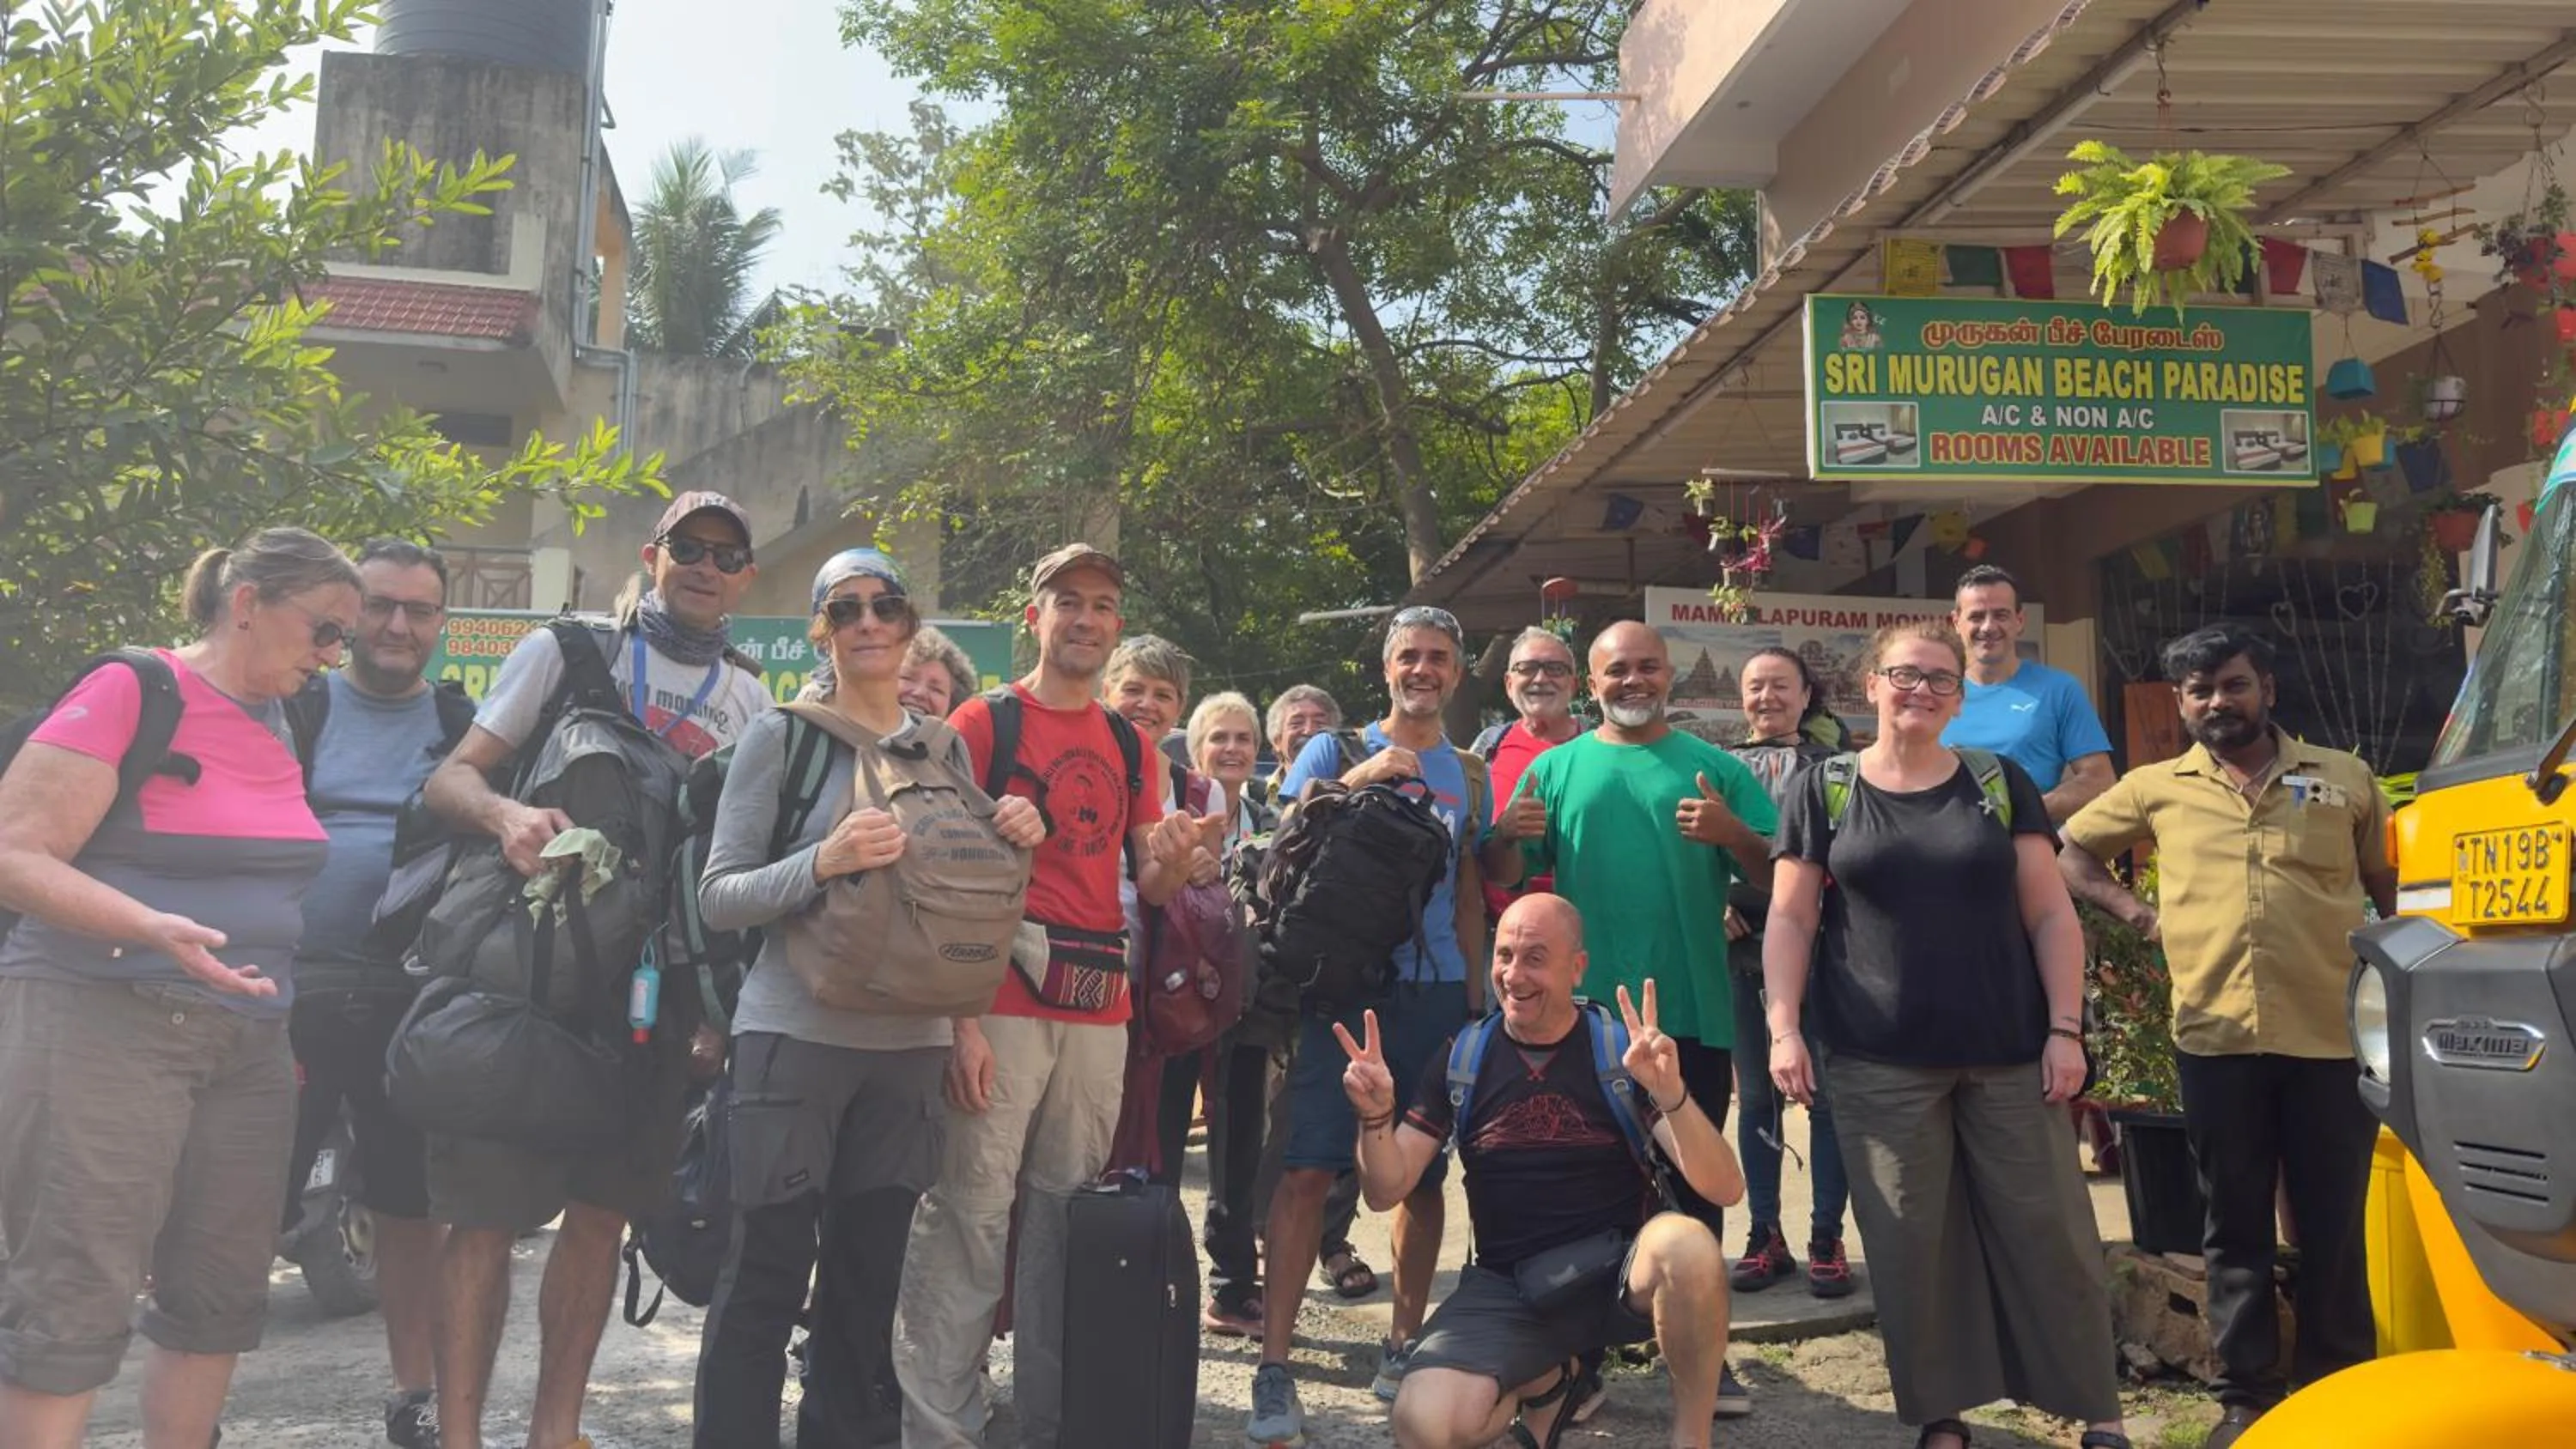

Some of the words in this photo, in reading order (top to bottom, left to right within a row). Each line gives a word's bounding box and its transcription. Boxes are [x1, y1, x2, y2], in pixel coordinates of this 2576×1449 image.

[1921, 317, 2042, 350] முருகன்
[2045, 315, 2087, 346] பீச்
[1825, 353, 1876, 395] SRI
[1889, 355, 2044, 397] MURUGAN
[2054, 357, 2154, 400] BEACH
[2163, 359, 2306, 405] PARADISE
[1981, 404, 2020, 427] A/C
[2030, 405, 2047, 427] &
[2056, 406, 2108, 428] NON
[2116, 408, 2154, 430] A/C
[1930, 432, 2045, 465] ROOMS
[2047, 433, 2213, 468] AVAILABLE
[447, 617, 538, 636] 994062
[1672, 603, 1868, 629] MAMLAPURAM
[446, 637, 518, 657] 98403
